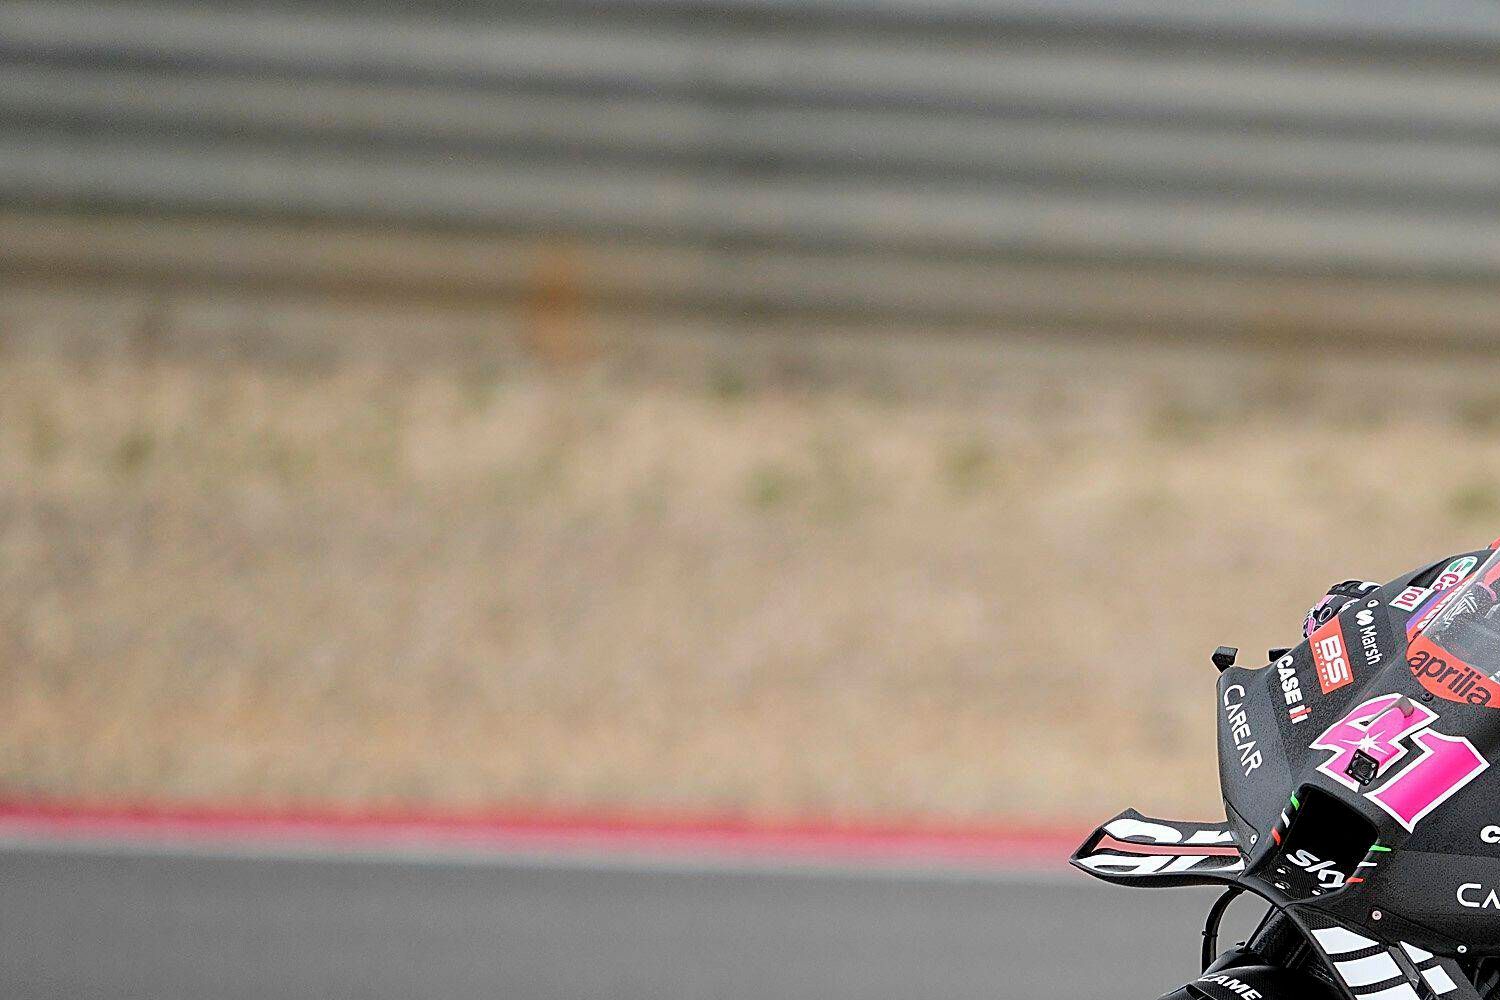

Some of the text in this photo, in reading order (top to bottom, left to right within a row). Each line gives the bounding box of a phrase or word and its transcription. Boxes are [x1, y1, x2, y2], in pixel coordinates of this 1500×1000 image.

[1319, 634, 1349, 684] BS
[1358, 621, 1383, 666] Marsh
[1276, 655, 1304, 704] CASE
[1407, 649, 1493, 706] aprilia
[1223, 684, 1263, 777] CAREAR
[1309, 692, 1490, 833] 41
[1285, 850, 1347, 889] sky
